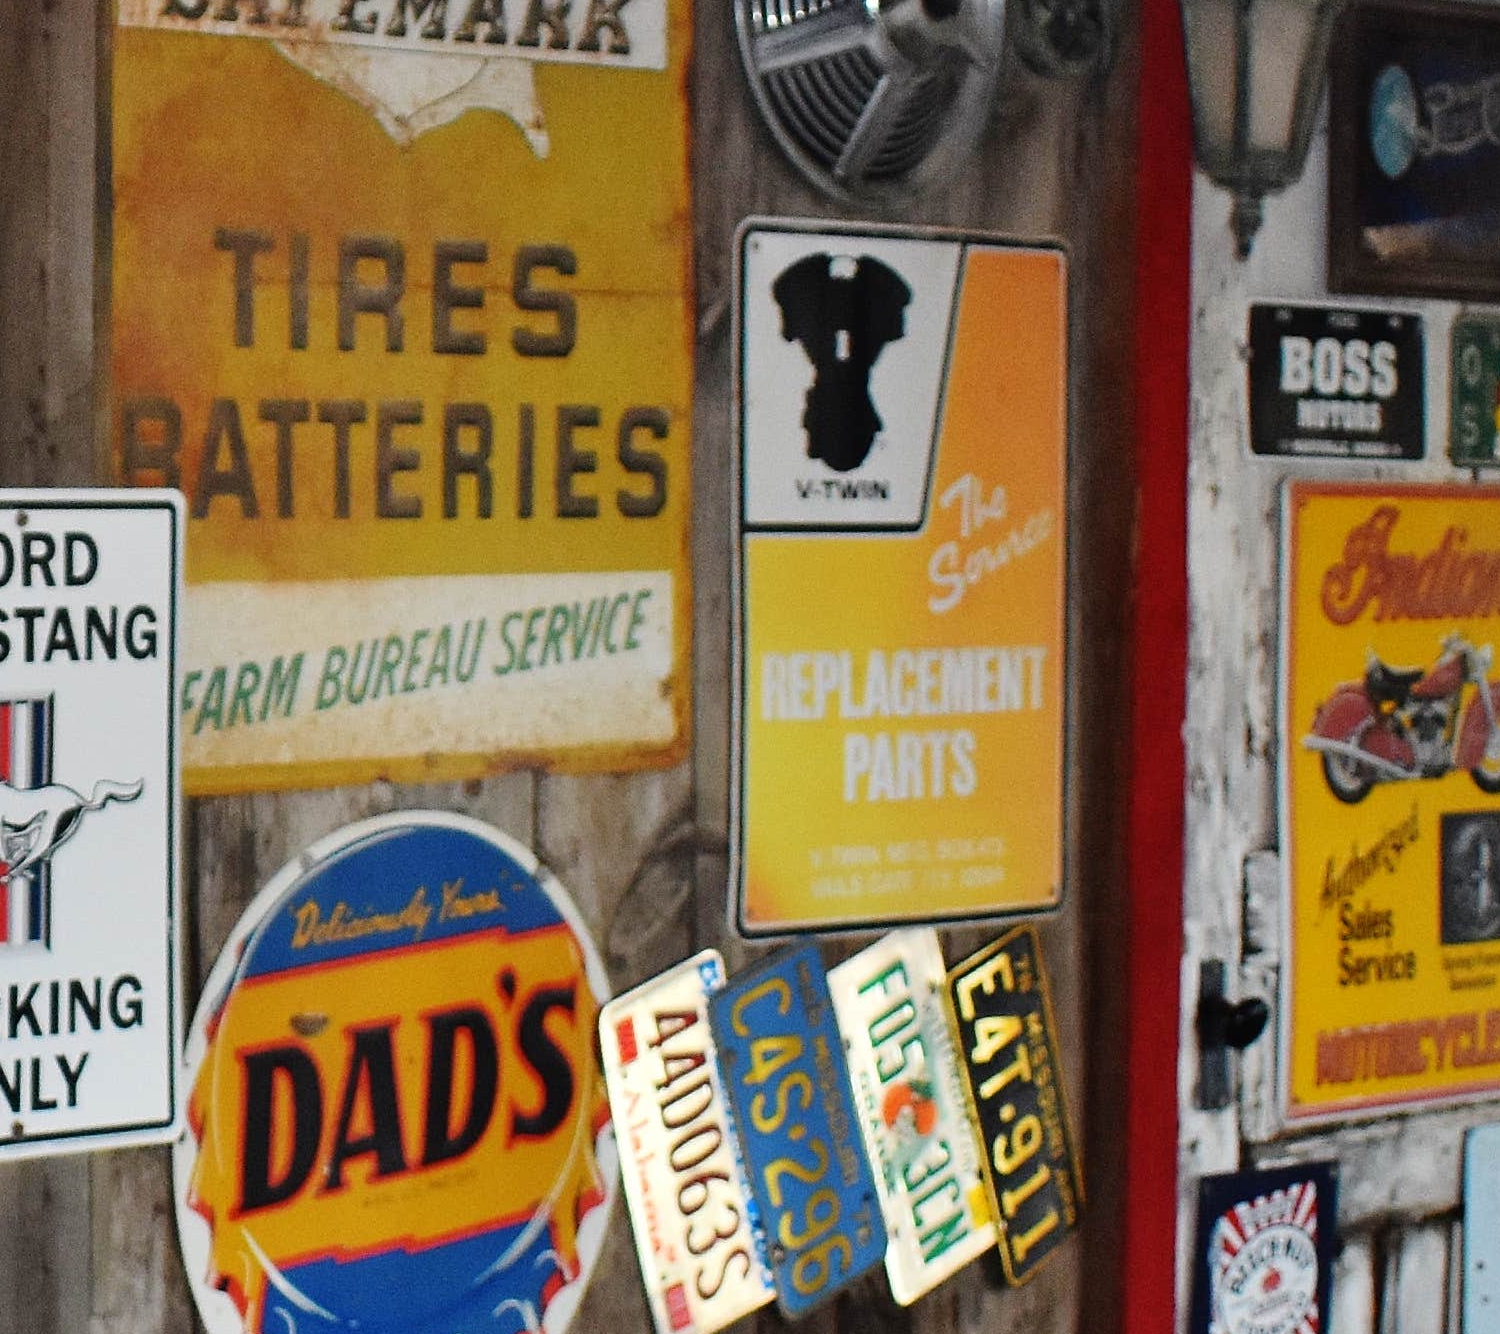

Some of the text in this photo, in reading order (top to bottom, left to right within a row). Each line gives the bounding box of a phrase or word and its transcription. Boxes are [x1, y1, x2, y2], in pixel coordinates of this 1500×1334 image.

[213, 227, 577, 358] TIRES
[1279, 335, 1398, 398] BOSS
[112, 397, 671, 521] BATTERIES
[795, 479, 889, 502] V-TWIN
[183, 589, 652, 735] FARM BUREAU SERVICE
[759, 645, 1046, 720] REPLACEMENT
[843, 729, 978, 803] PARTS
[236, 961, 576, 1215] DAD'S
